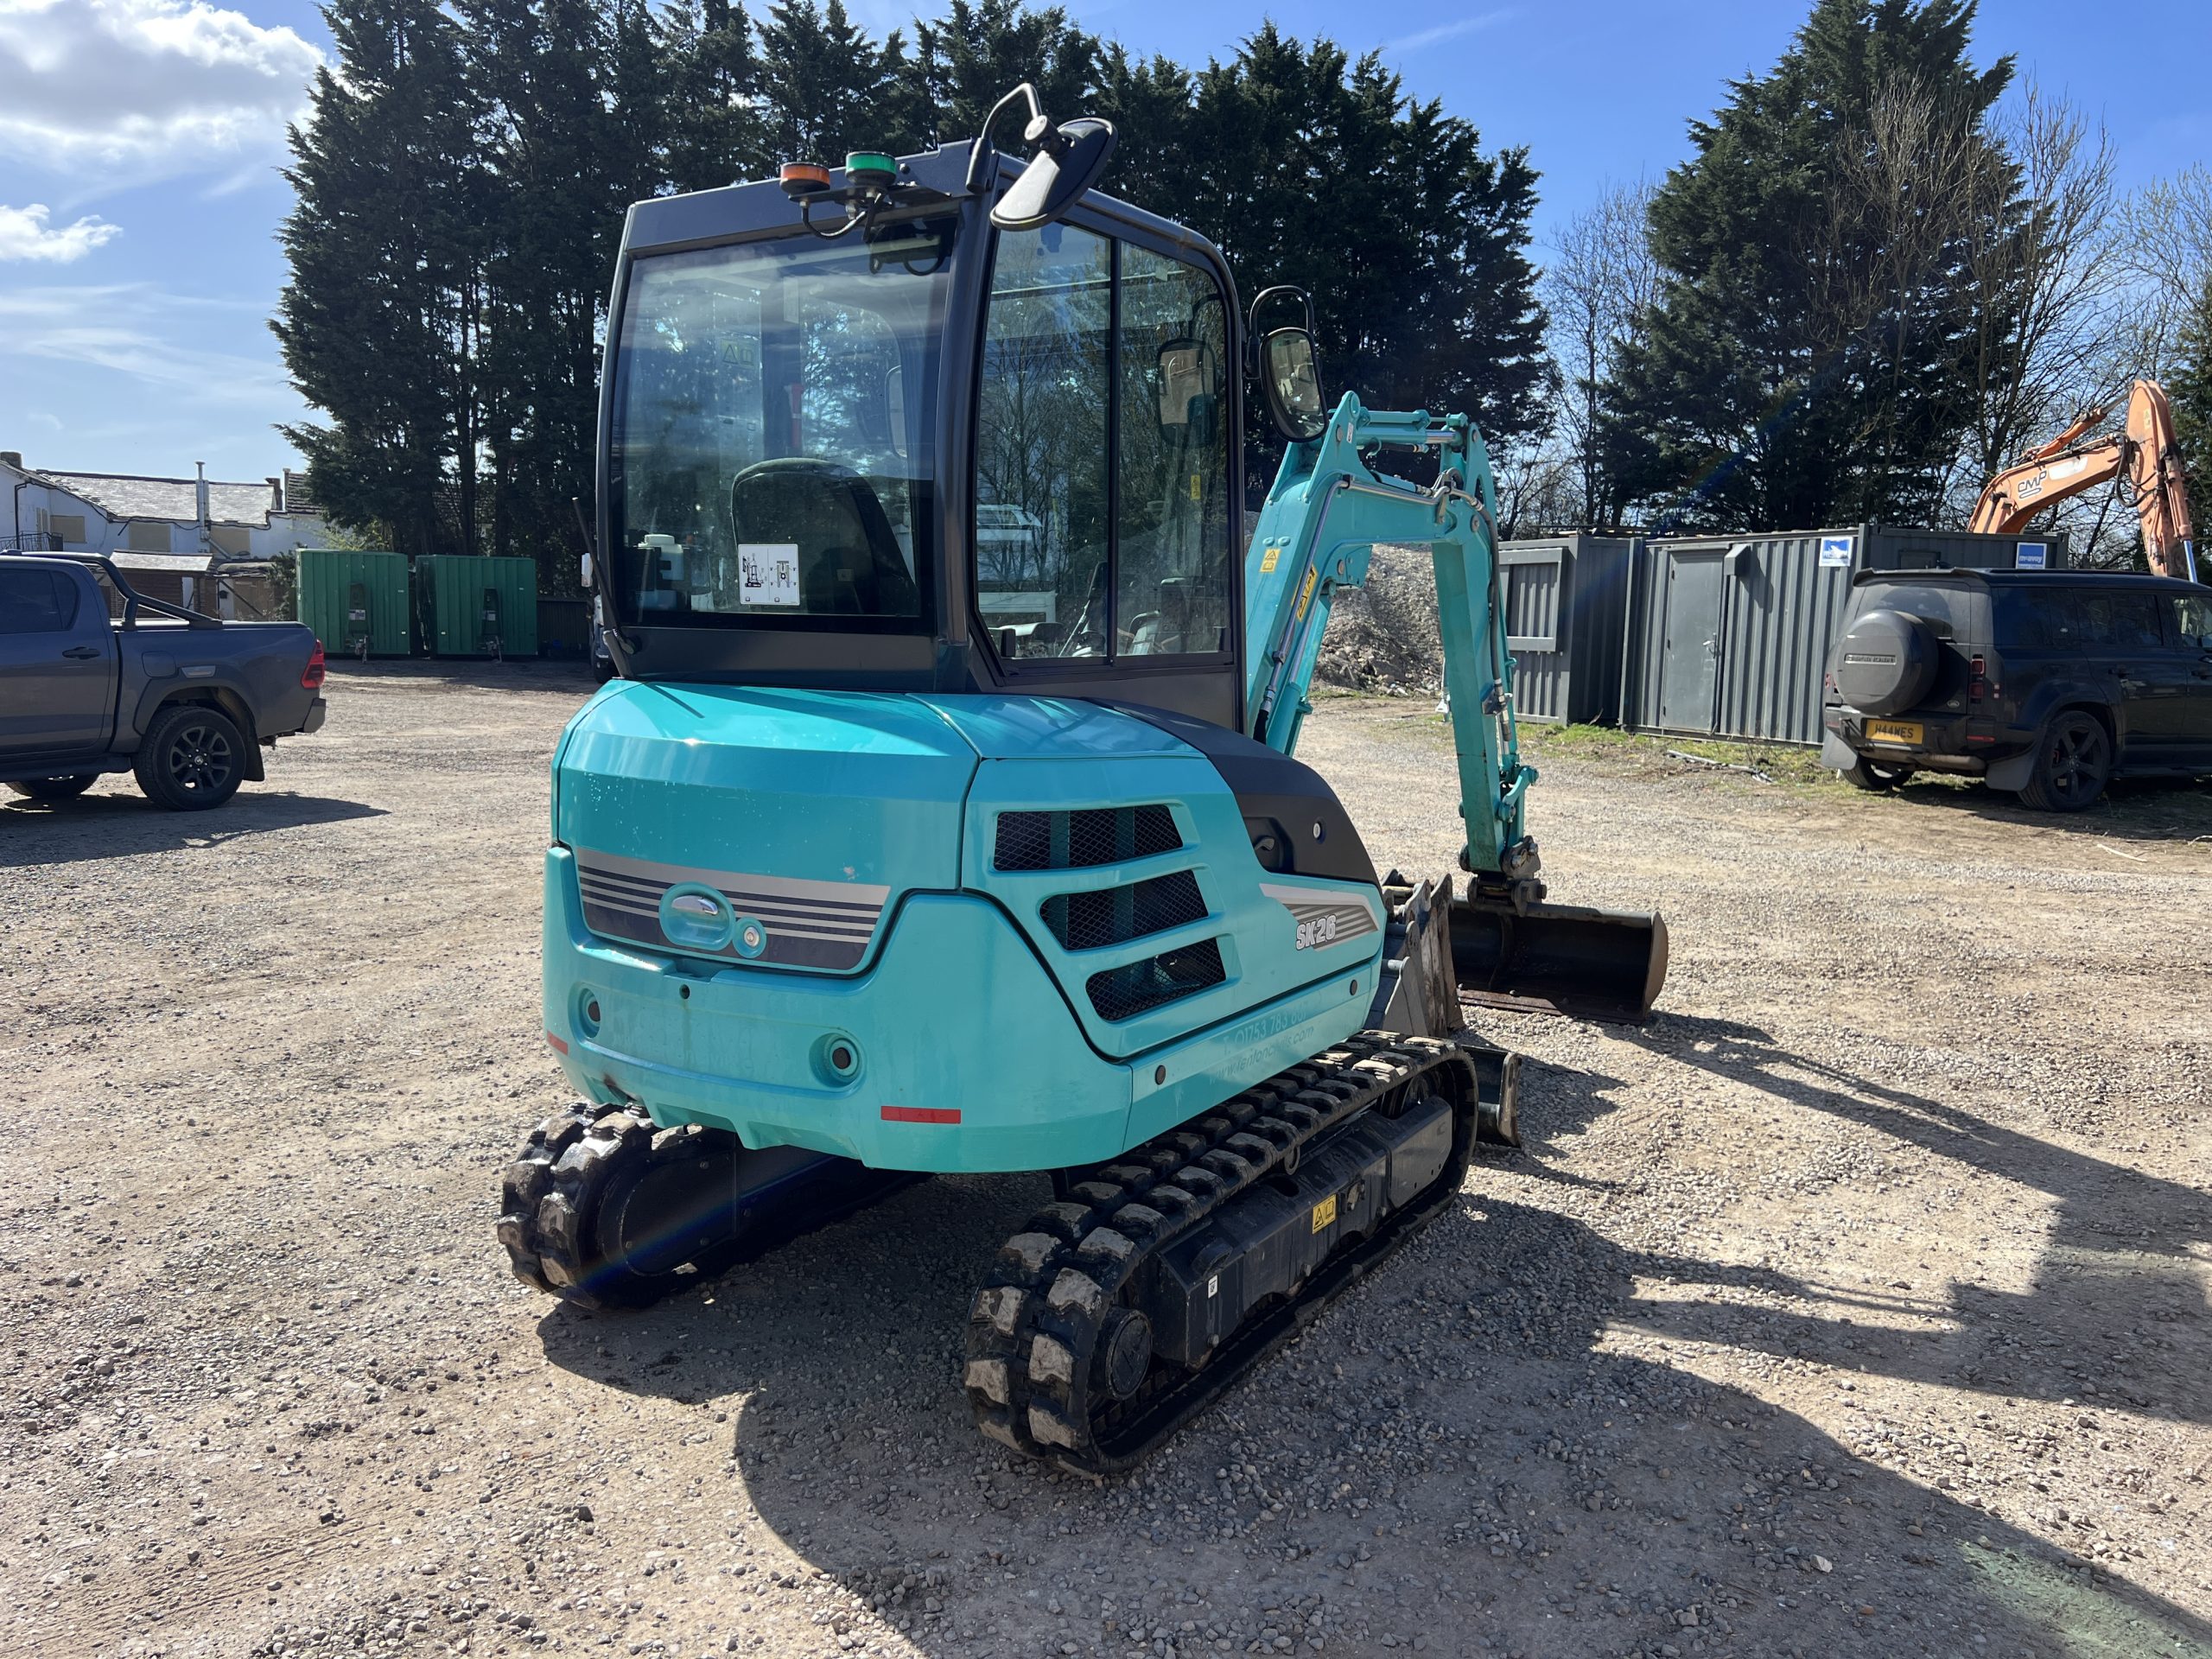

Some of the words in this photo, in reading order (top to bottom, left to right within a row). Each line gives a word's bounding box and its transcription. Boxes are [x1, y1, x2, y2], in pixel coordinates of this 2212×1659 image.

[2018, 470, 2047, 493] CMP
[1296, 914, 1337, 950] SK26
[1235, 1020, 1267, 1049] 01753
[1270, 1011, 1287, 1034] 783
